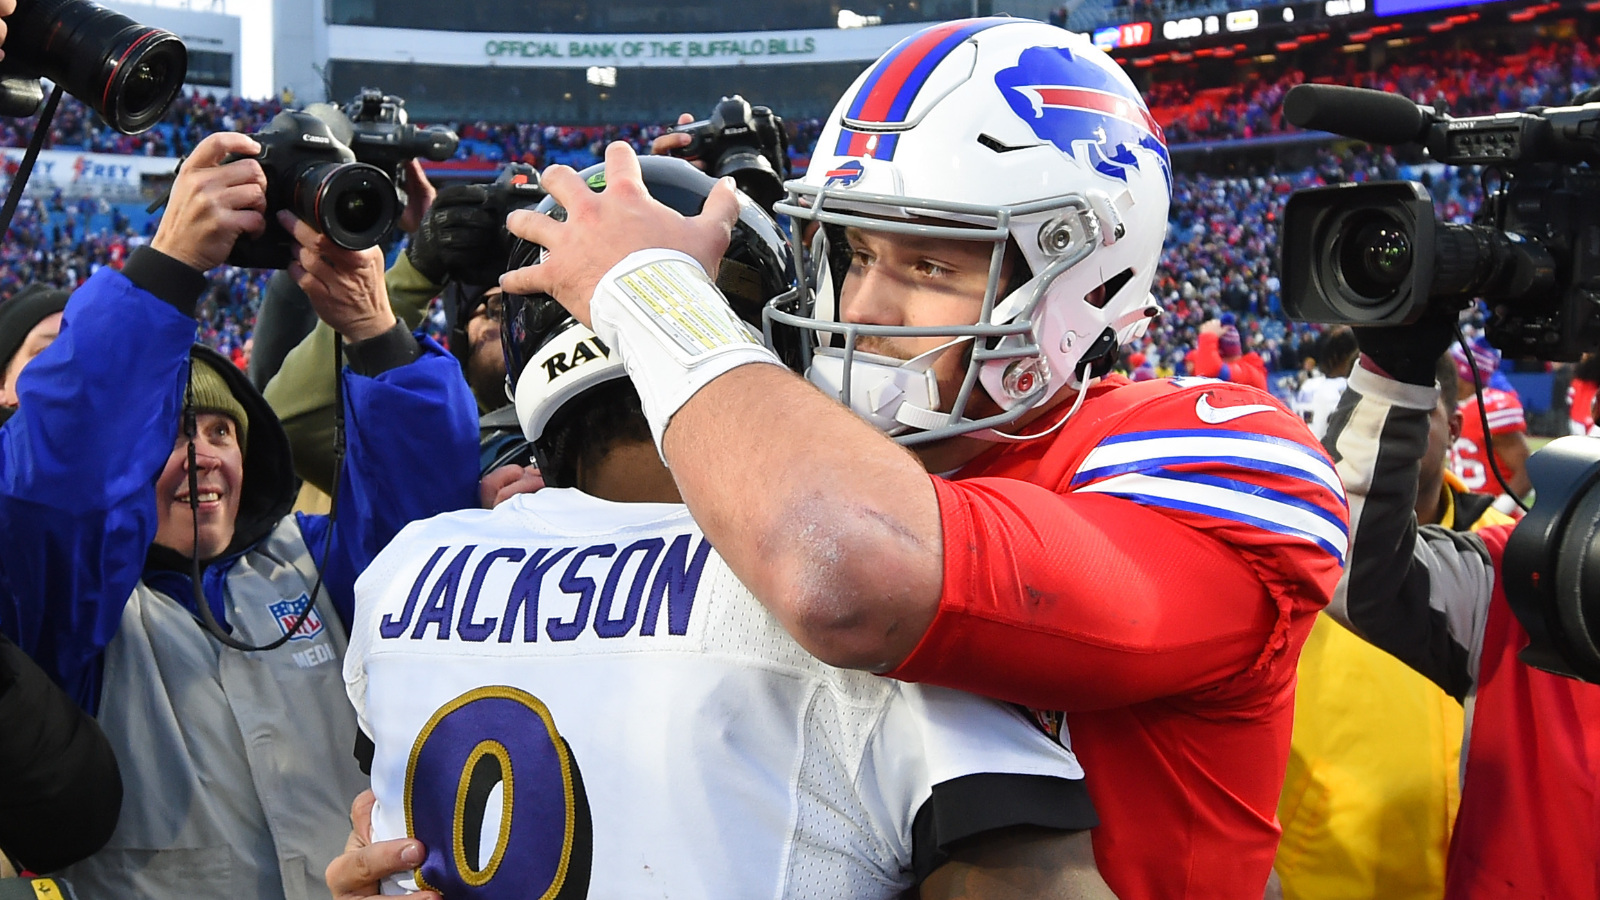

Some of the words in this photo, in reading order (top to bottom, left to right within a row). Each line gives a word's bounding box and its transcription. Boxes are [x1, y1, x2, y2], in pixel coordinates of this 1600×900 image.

[485, 40, 563, 57] OFFICIAL
[569, 41, 617, 57] BANK
[621, 41, 645, 57] OF
[649, 41, 682, 57] THE
[687, 39, 765, 57] BUFFALO
[768, 37, 815, 55] BILLS
[724, 127, 748, 135] Nikon
[1448, 121, 1477, 130] SONY
[303, 133, 330, 144] Canon
[379, 534, 713, 643] JACKSON
